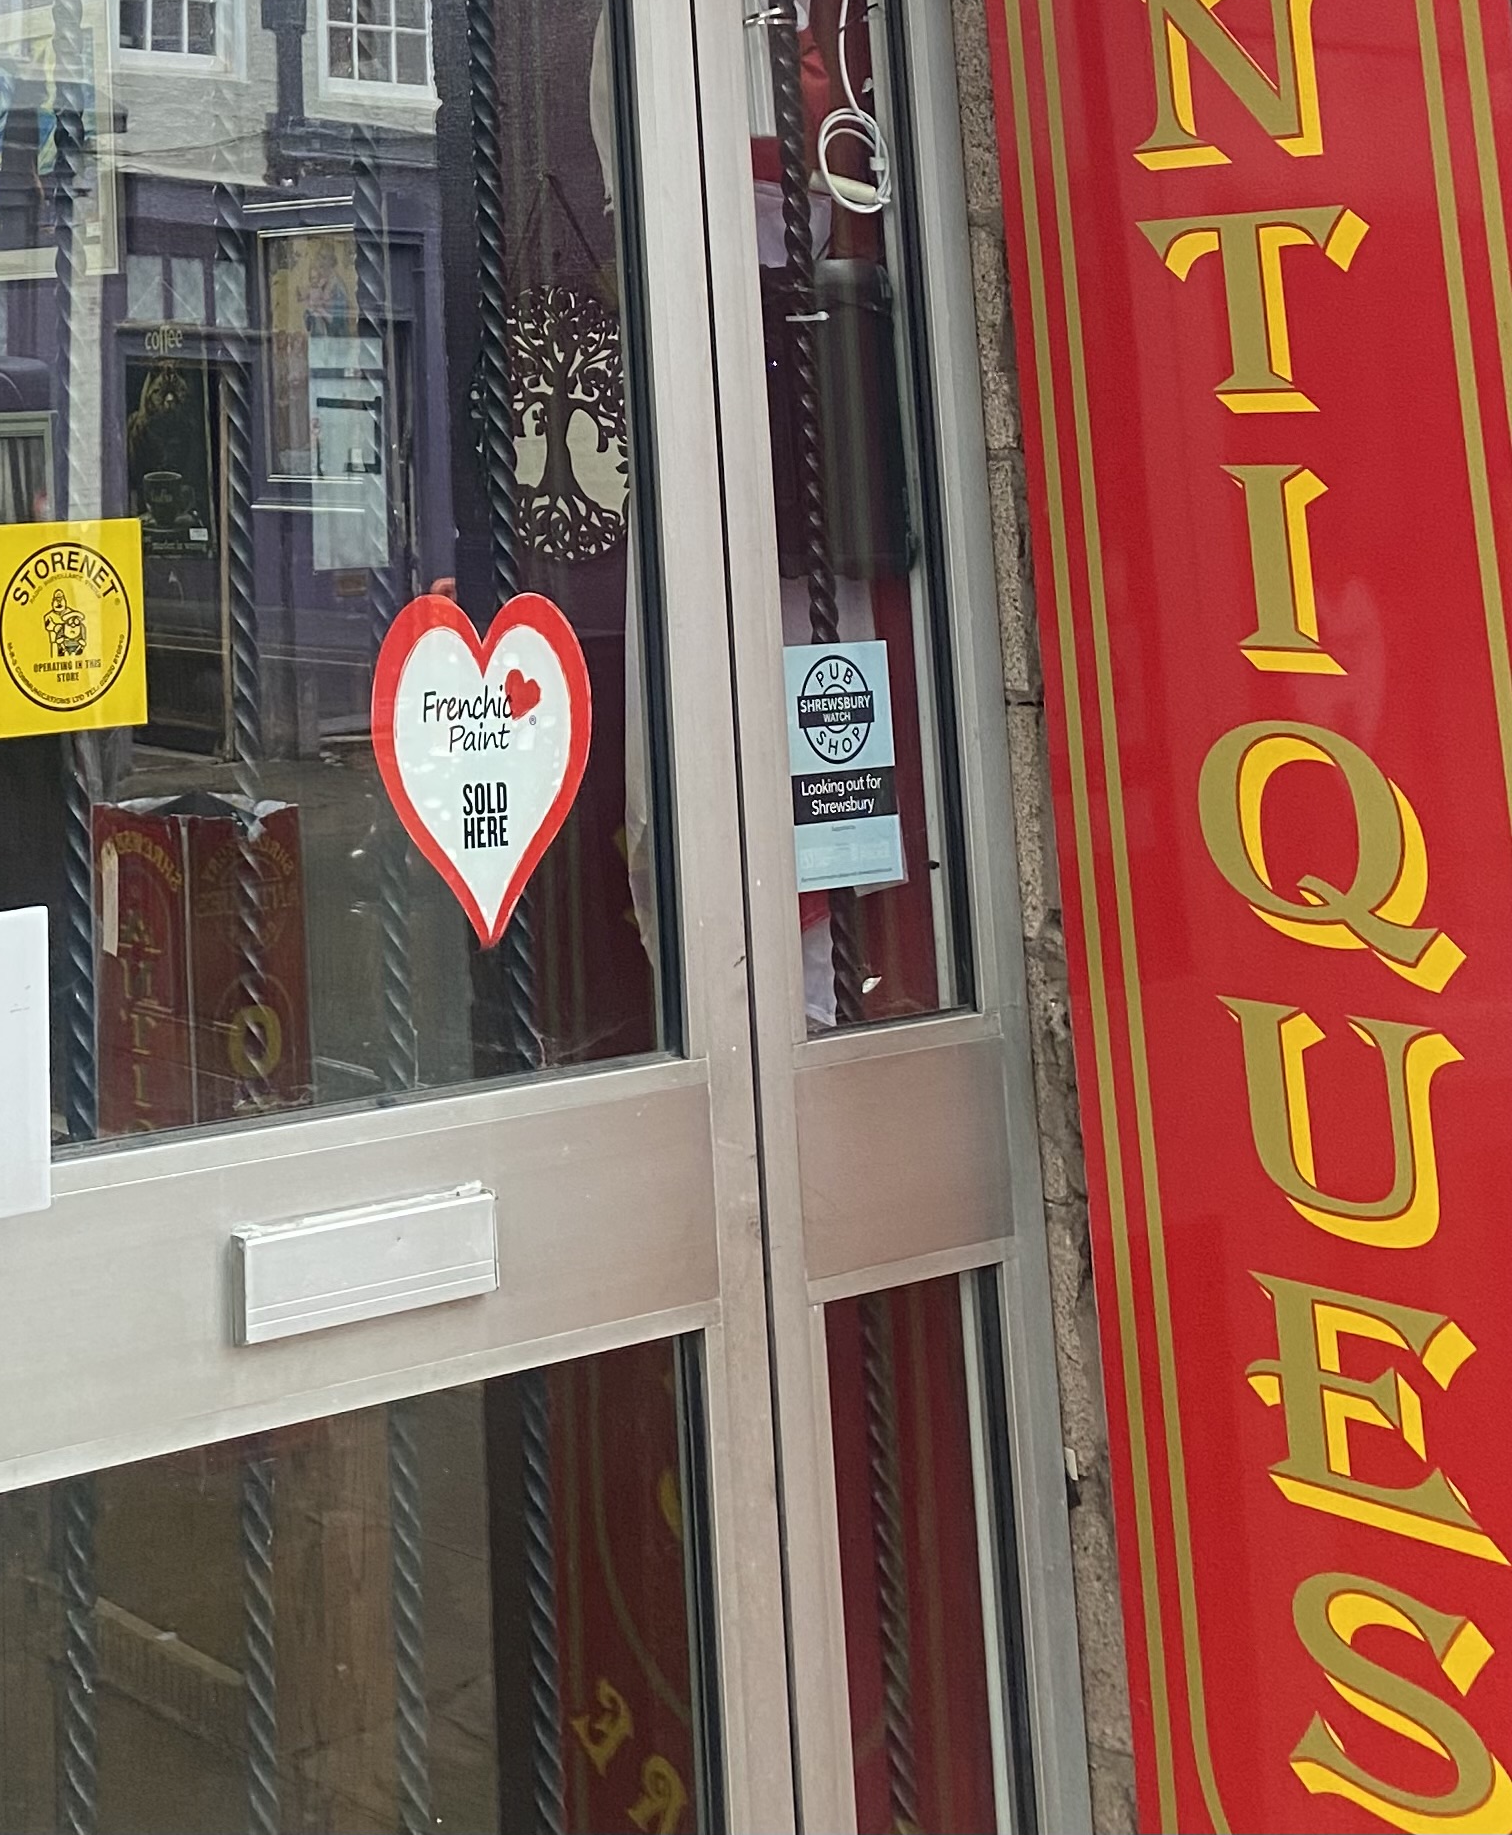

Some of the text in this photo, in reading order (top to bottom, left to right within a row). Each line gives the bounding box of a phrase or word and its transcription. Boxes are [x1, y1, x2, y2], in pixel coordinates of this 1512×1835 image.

[144, 324, 184, 355] coffee
[12, 550, 119, 607] STORENET
[33, 658, 102, 674] OPERATING IN THIS
[56, 670, 80, 683] STORE
[815, 662, 854, 688] PUB
[422, 684, 515, 723] Frenchic
[799, 694, 871, 713] SHREWSBURY
[822, 711, 851, 723] WATCH
[449, 721, 511, 754] Paint
[815, 726, 861, 756] SHOP
[462, 781, 508, 816] SOLD
[801, 773, 882, 797] Looking out for
[811, 795, 875, 816] Shrewsbury
[463, 814, 509, 850] HERE
